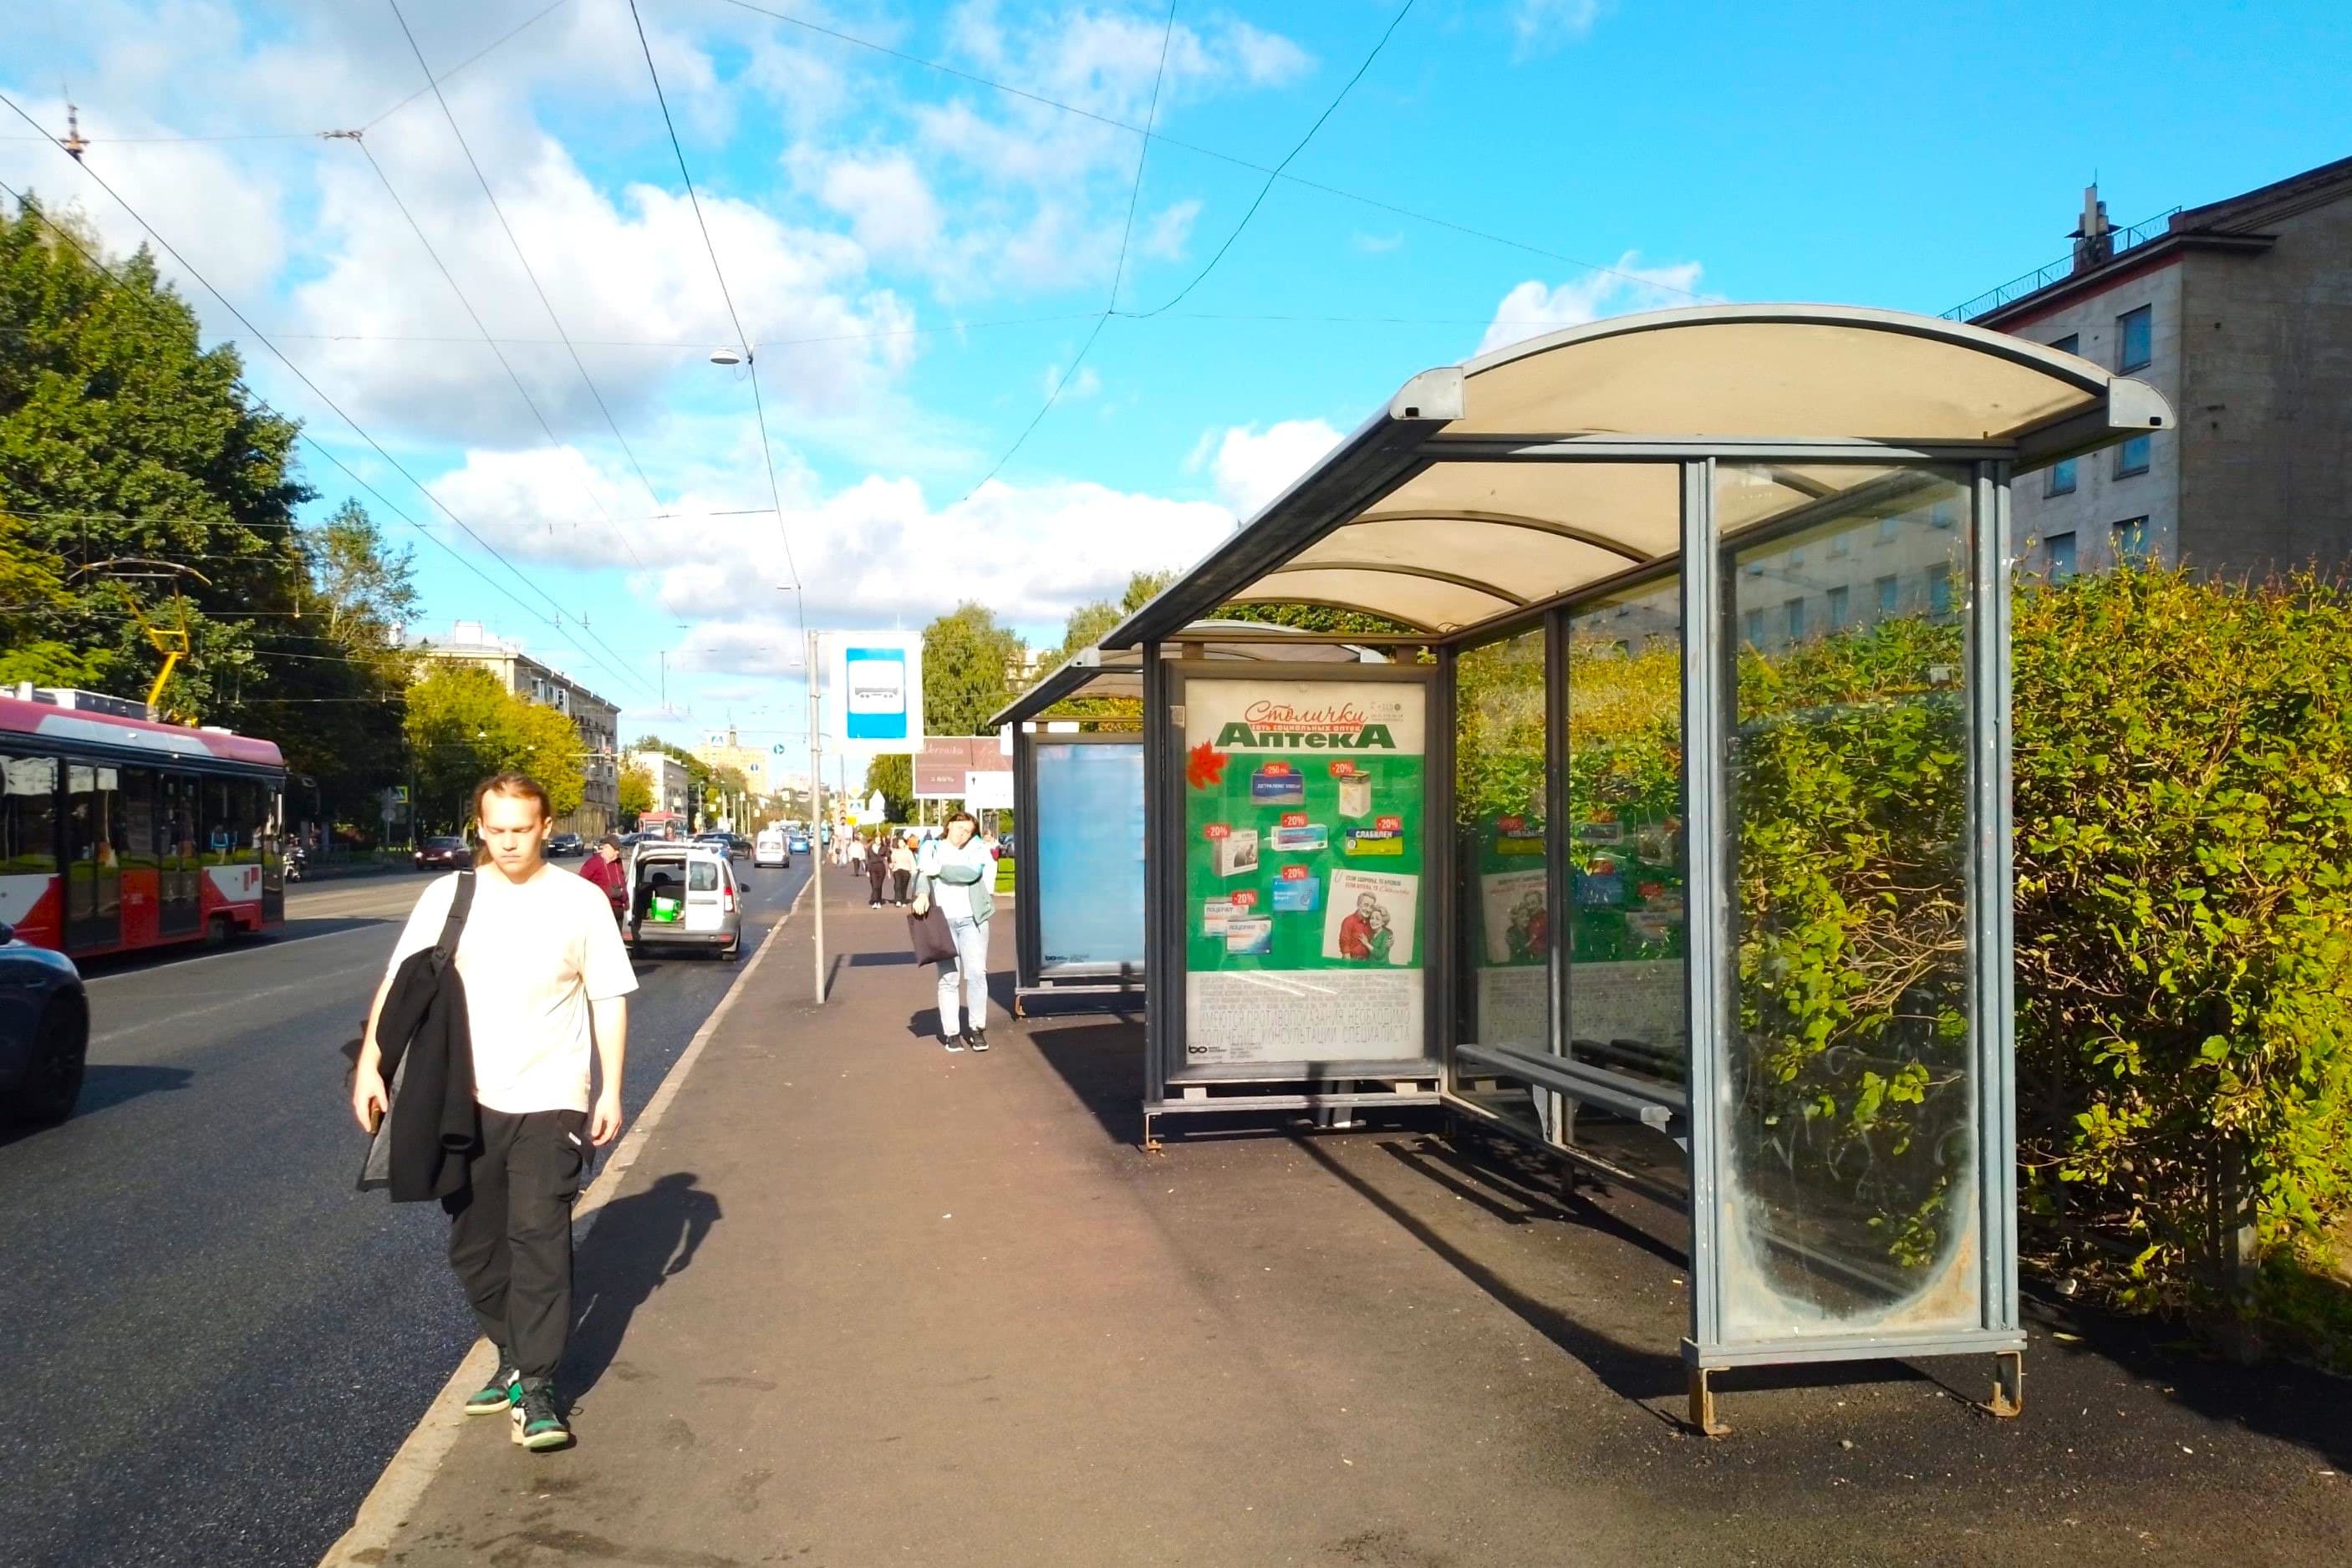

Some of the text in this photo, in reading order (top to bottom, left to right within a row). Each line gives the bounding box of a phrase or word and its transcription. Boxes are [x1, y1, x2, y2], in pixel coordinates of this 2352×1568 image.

[1245, 700, 1368, 723] Столички
[1331, 763, 1352, 773] -20%
[1284, 815, 1305, 826] -20%
[1378, 818, 1398, 829] -20%
[1207, 826, 1228, 837] -20%
[1285, 868, 1305, 878] -20%
[1234, 893, 1255, 904] -20%
